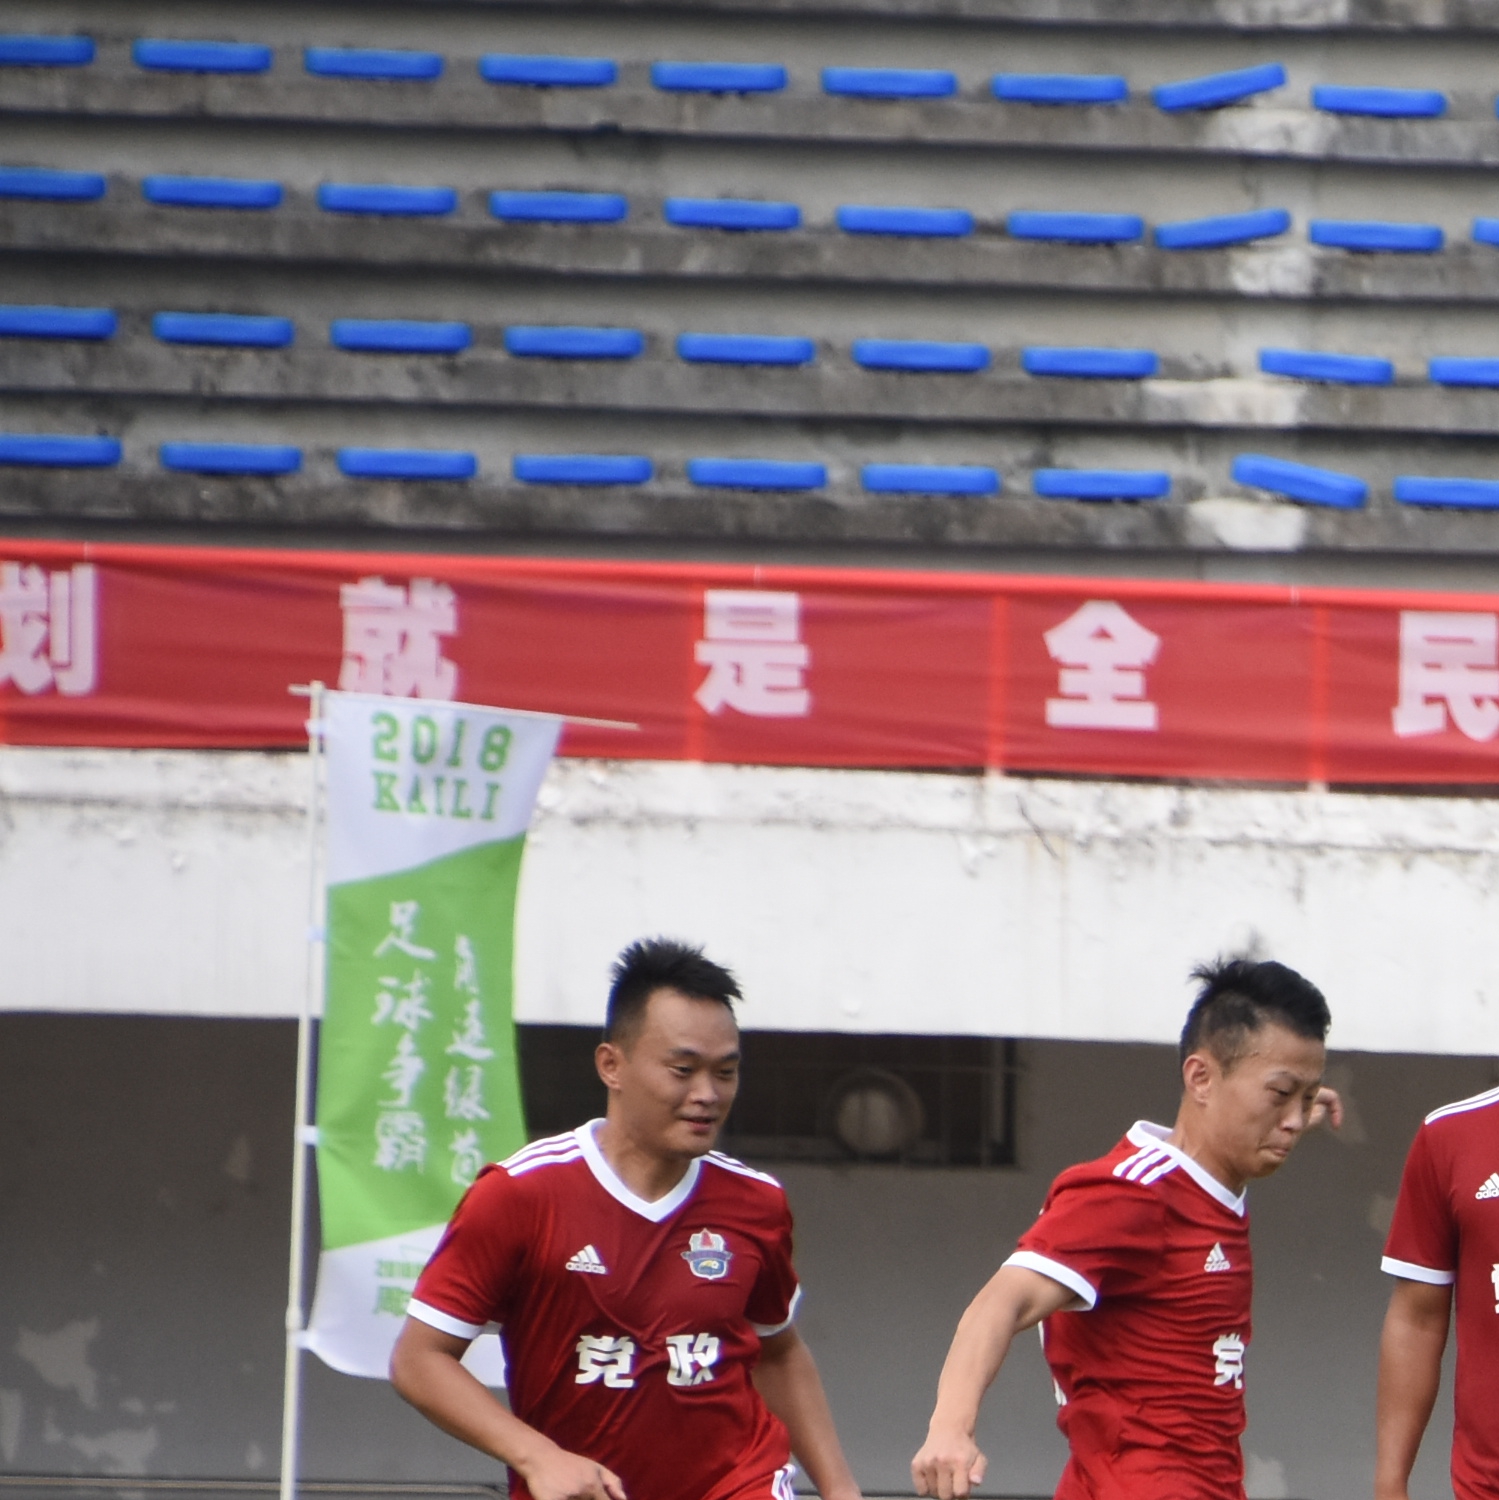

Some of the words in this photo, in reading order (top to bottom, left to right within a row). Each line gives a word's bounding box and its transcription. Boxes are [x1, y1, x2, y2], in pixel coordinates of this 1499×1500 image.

[371, 710, 513, 772] 2018
[372, 769, 502, 821] KAILI
[565, 1261, 607, 1275] adidas
[574, 1332, 720, 1389] 党政
